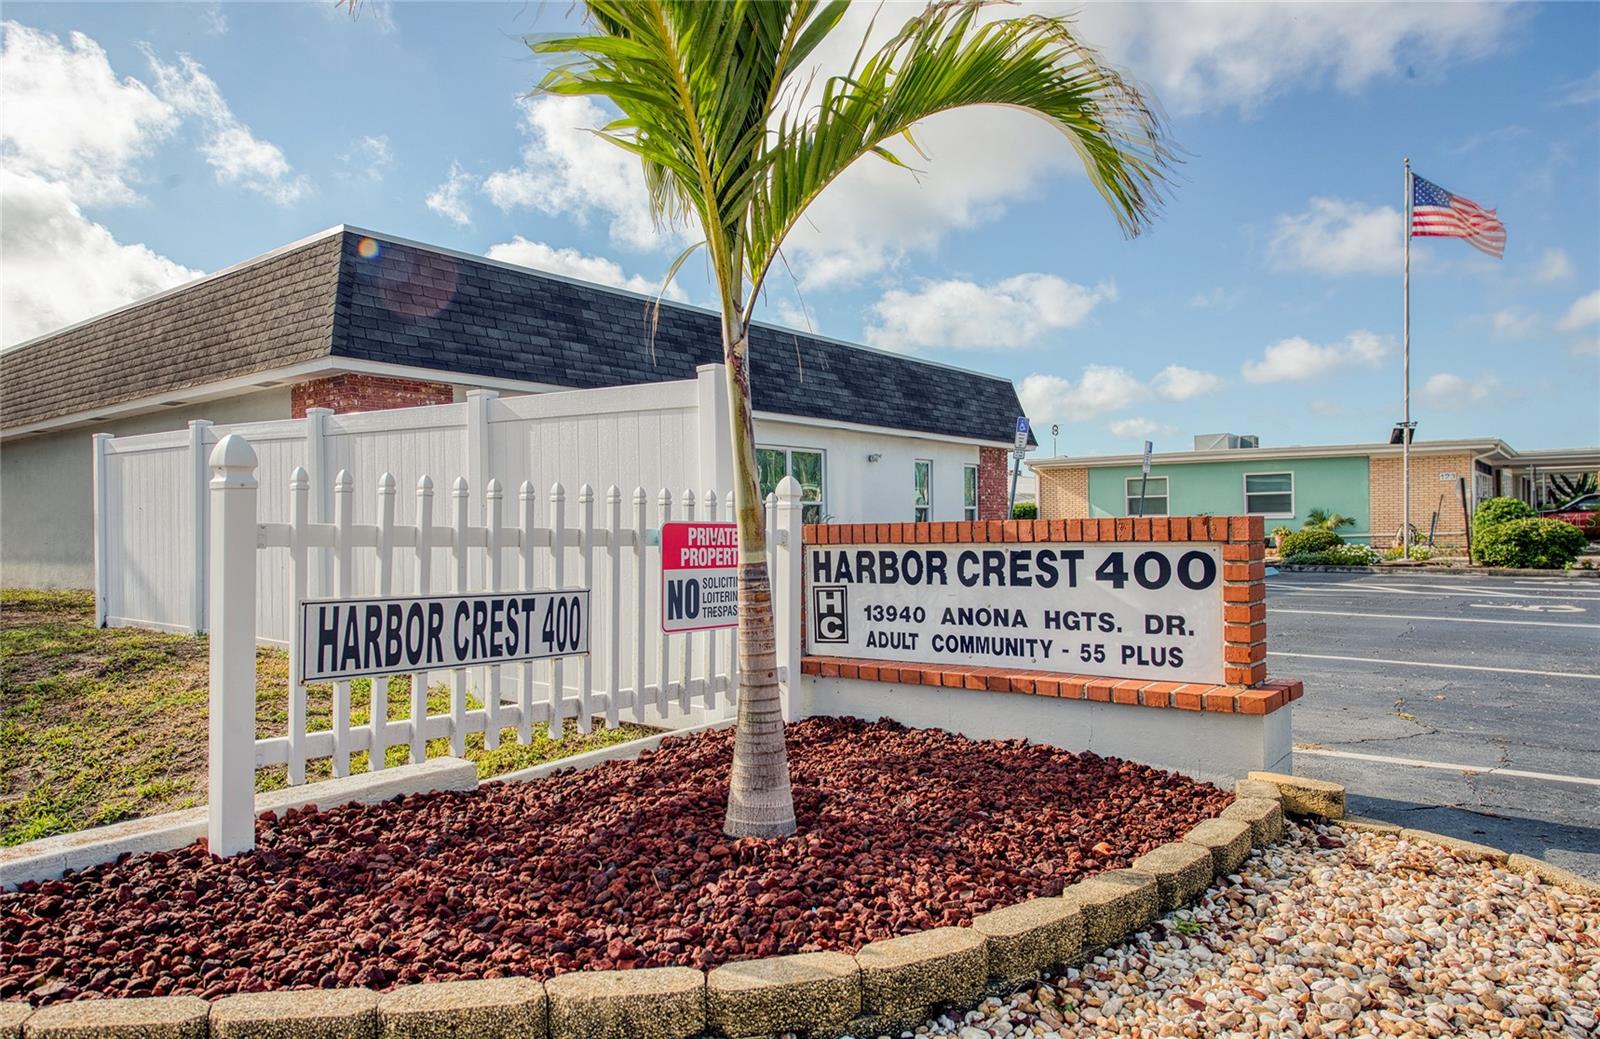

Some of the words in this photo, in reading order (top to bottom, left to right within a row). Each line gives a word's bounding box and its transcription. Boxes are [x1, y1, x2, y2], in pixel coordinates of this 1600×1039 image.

[688, 527, 738, 546] PRIVATE
[681, 547, 738, 567] PROPERT
[812, 549, 948, 586] HARBOR
[956, 549, 1085, 588] CREST
[1095, 550, 1217, 590] 400
[702, 576, 738, 589] SOLICITI
[667, 578, 700, 620] NO
[702, 590, 738, 603] LOITERIN
[702, 604, 738, 618] TRESPAS
[864, 605, 926, 623] 13940
[941, 607, 1028, 628] ANONA
[1044, 610, 1122, 633] HGTS.
[1145, 614, 1195, 636] DR.
[317, 602, 444, 673] HARBOR
[453, 598, 536, 662] CREST
[542, 596, 581, 653] 400
[866, 630, 919, 650] ADULT
[931, 634, 1054, 659] COMMUNITY
[1080, 643, 1106, 663] 55
[1121, 645, 1184, 668] PLUS
